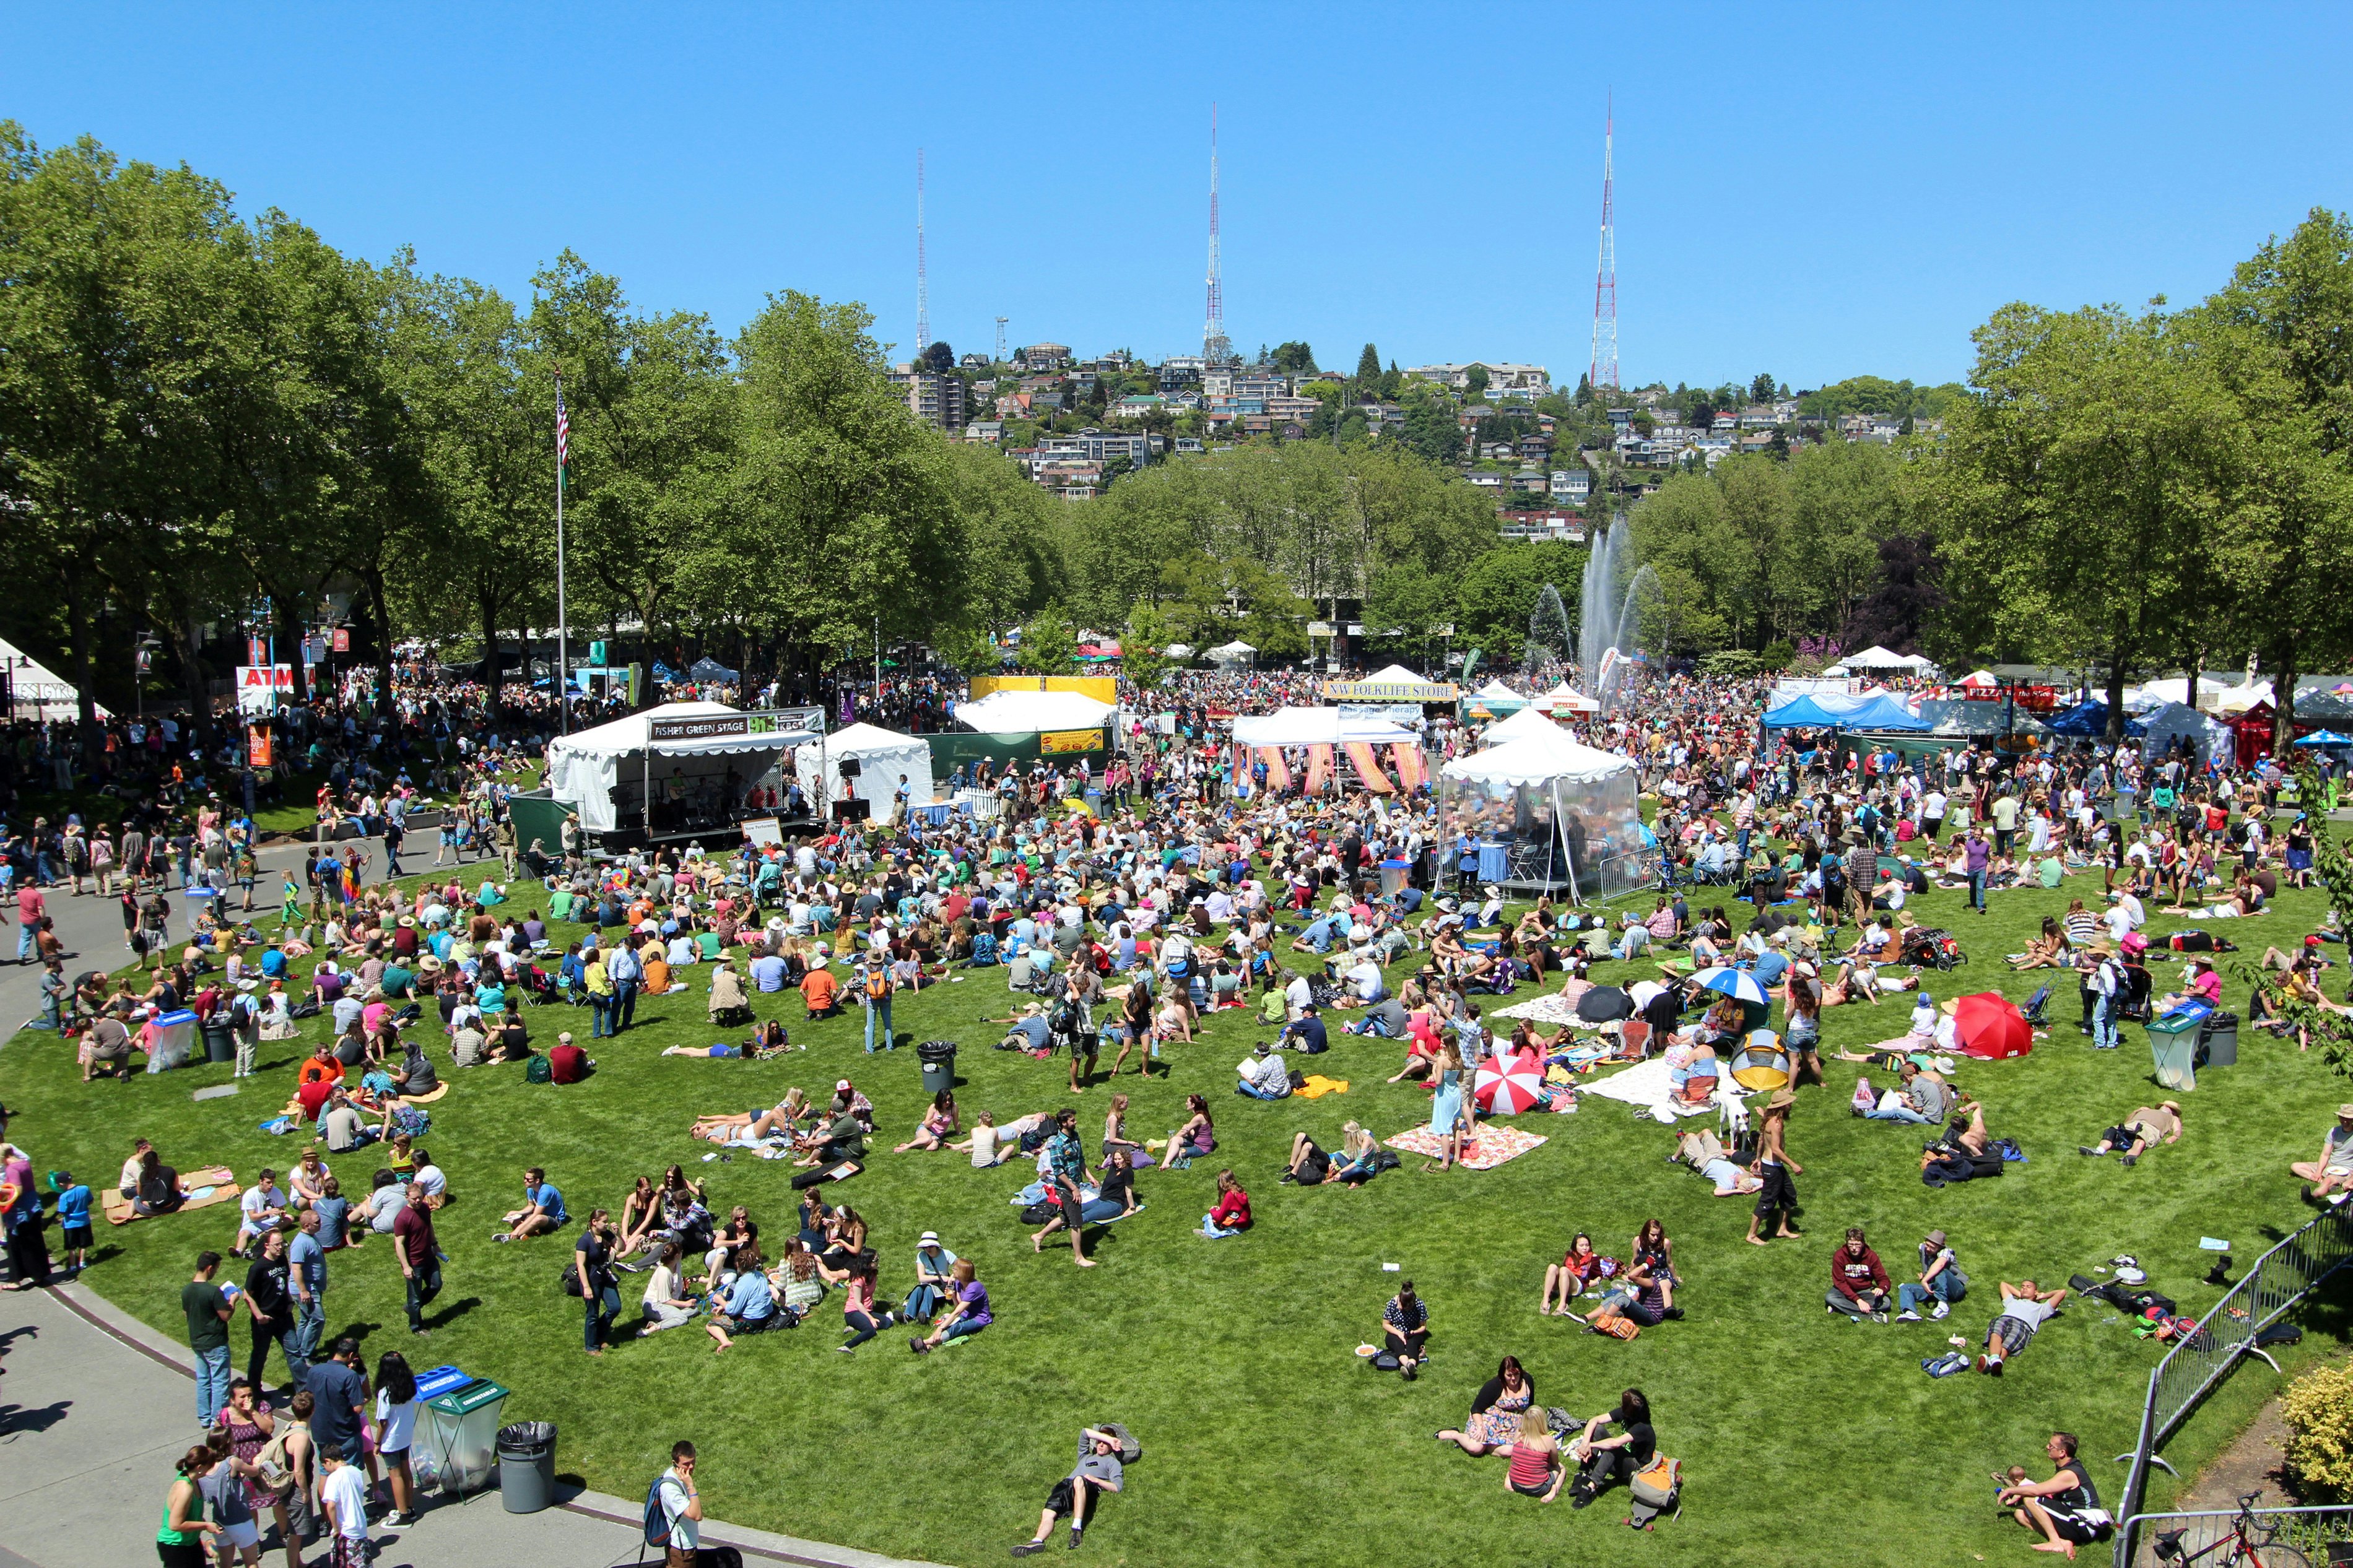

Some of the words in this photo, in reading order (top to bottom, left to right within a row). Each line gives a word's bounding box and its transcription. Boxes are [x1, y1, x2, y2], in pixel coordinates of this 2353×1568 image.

[245, 669, 294, 686] ATM
[1329, 684, 1350, 695] NW
[1353, 684, 1410, 696] FOLKLIFE
[1412, 685, 1452, 697] STORE
[1970, 688, 2003, 697] PIZZA
[1339, 705, 1380, 714] Massage
[1383, 706, 1420, 714] Therapy
[655, 725, 684, 736] FISHER
[686, 724, 716, 735] GREEN
[717, 722, 744, 733] STAGE
[780, 721, 804, 731] KBCS
[463, 1387, 498, 1406] COMPOSTABLES
